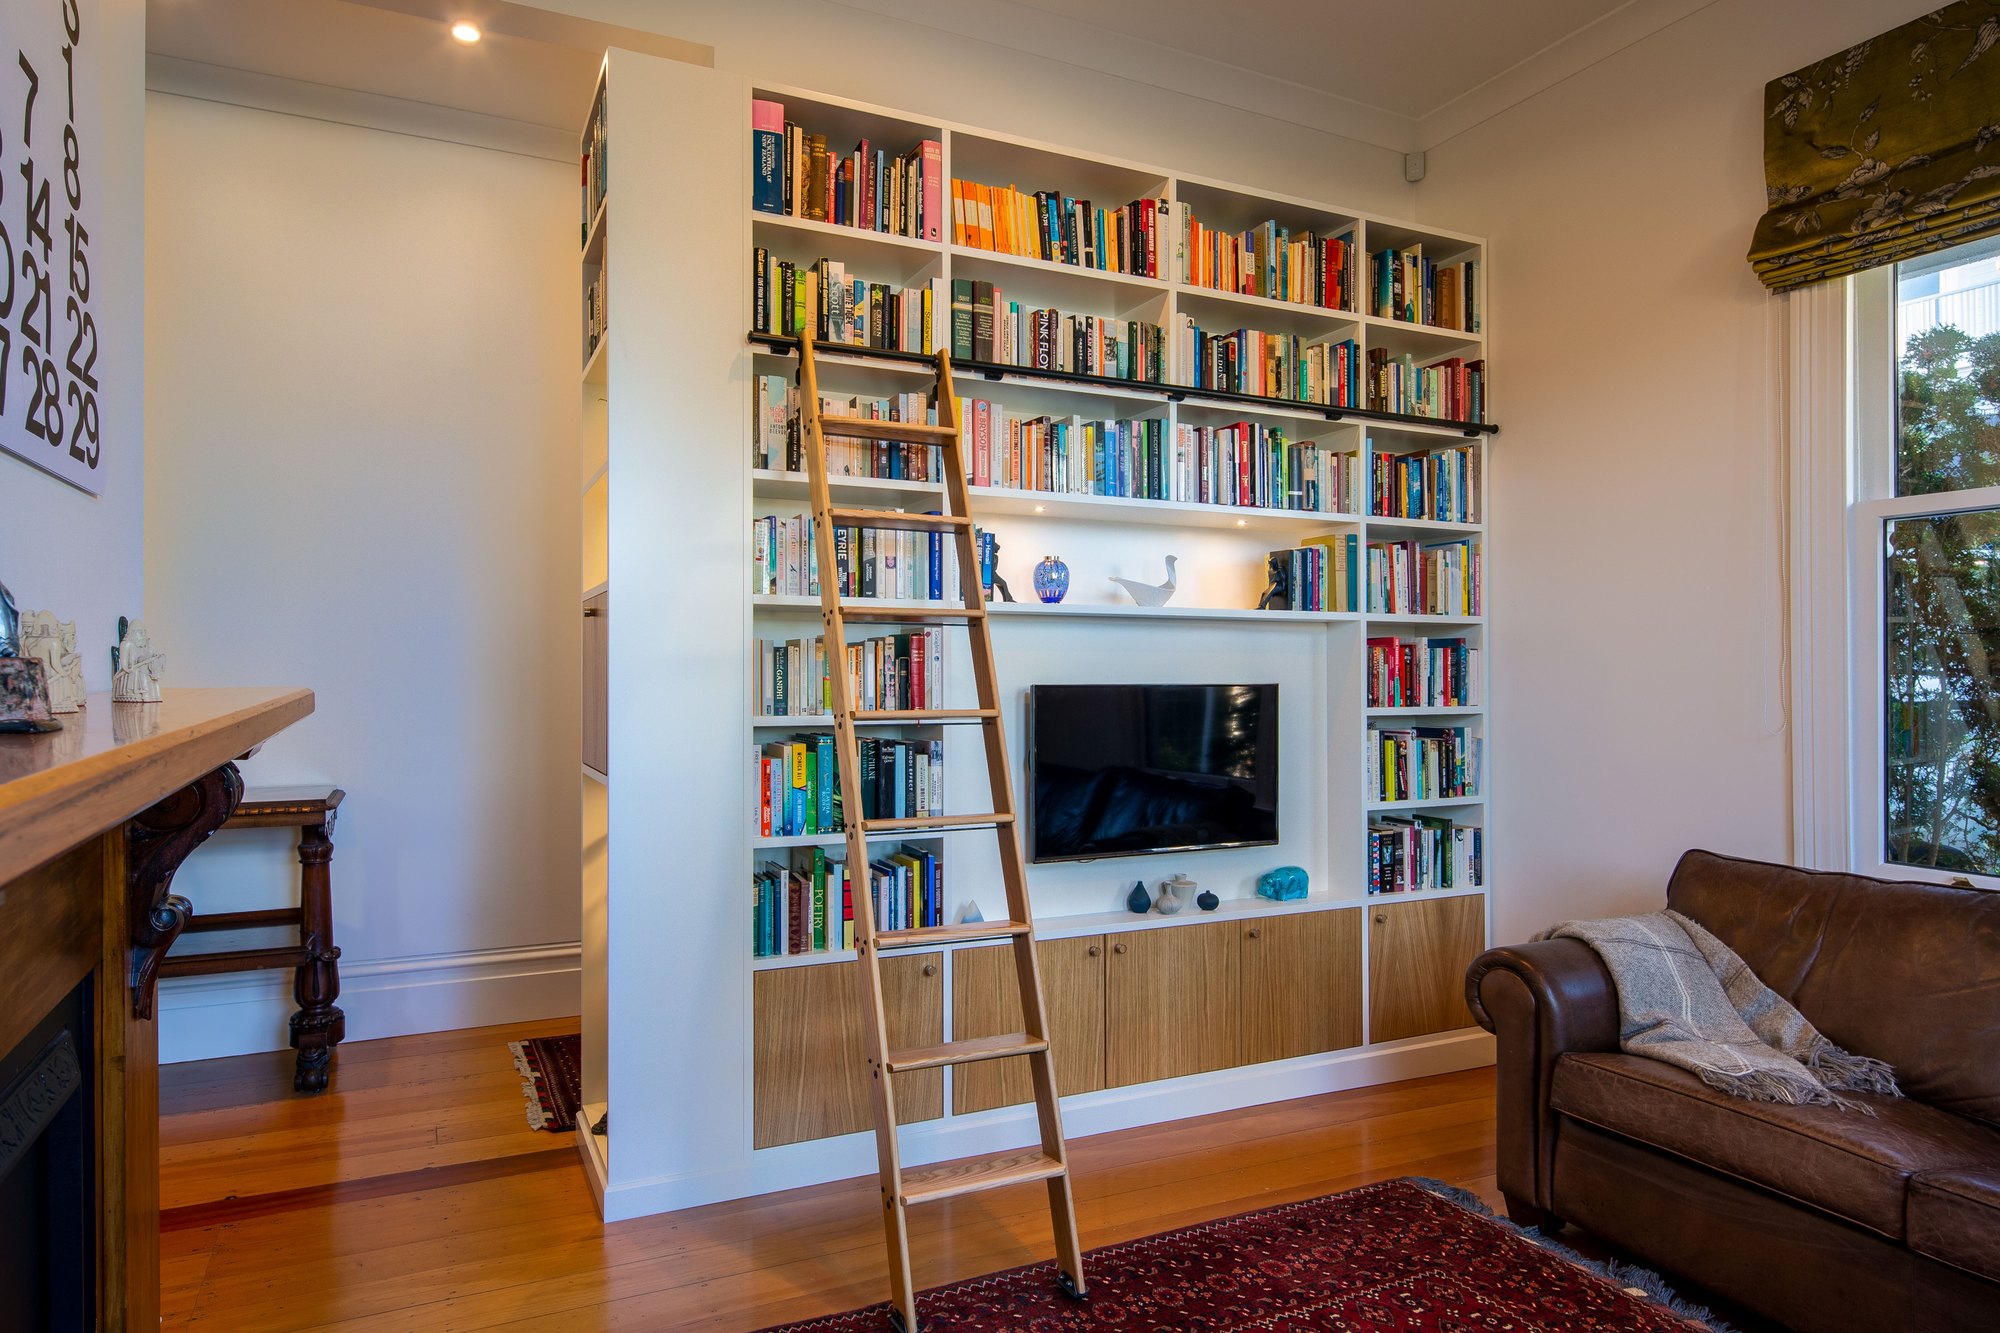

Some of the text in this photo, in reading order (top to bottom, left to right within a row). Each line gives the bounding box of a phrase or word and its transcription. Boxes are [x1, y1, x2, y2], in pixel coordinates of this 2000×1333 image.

[18, 49, 39, 149] 7
[61, 43, 74, 124] 1
[20, 157, 53, 265] 14
[63, 123, 81, 211] 8
[766, 174, 772, 183] OF
[20, 250, 51, 355] 21
[64, 213, 89, 304] 15
[831, 282, 841, 315] Scott
[66, 296, 98, 392] 22
[924, 311, 932, 342] Stasiland
[1040, 312, 1049, 370] PINK FLOY
[23, 345, 63, 447] 28
[67, 380, 100, 470] 29
[838, 529, 847, 560] EYRIE
[814, 889, 824, 930] POETRY
